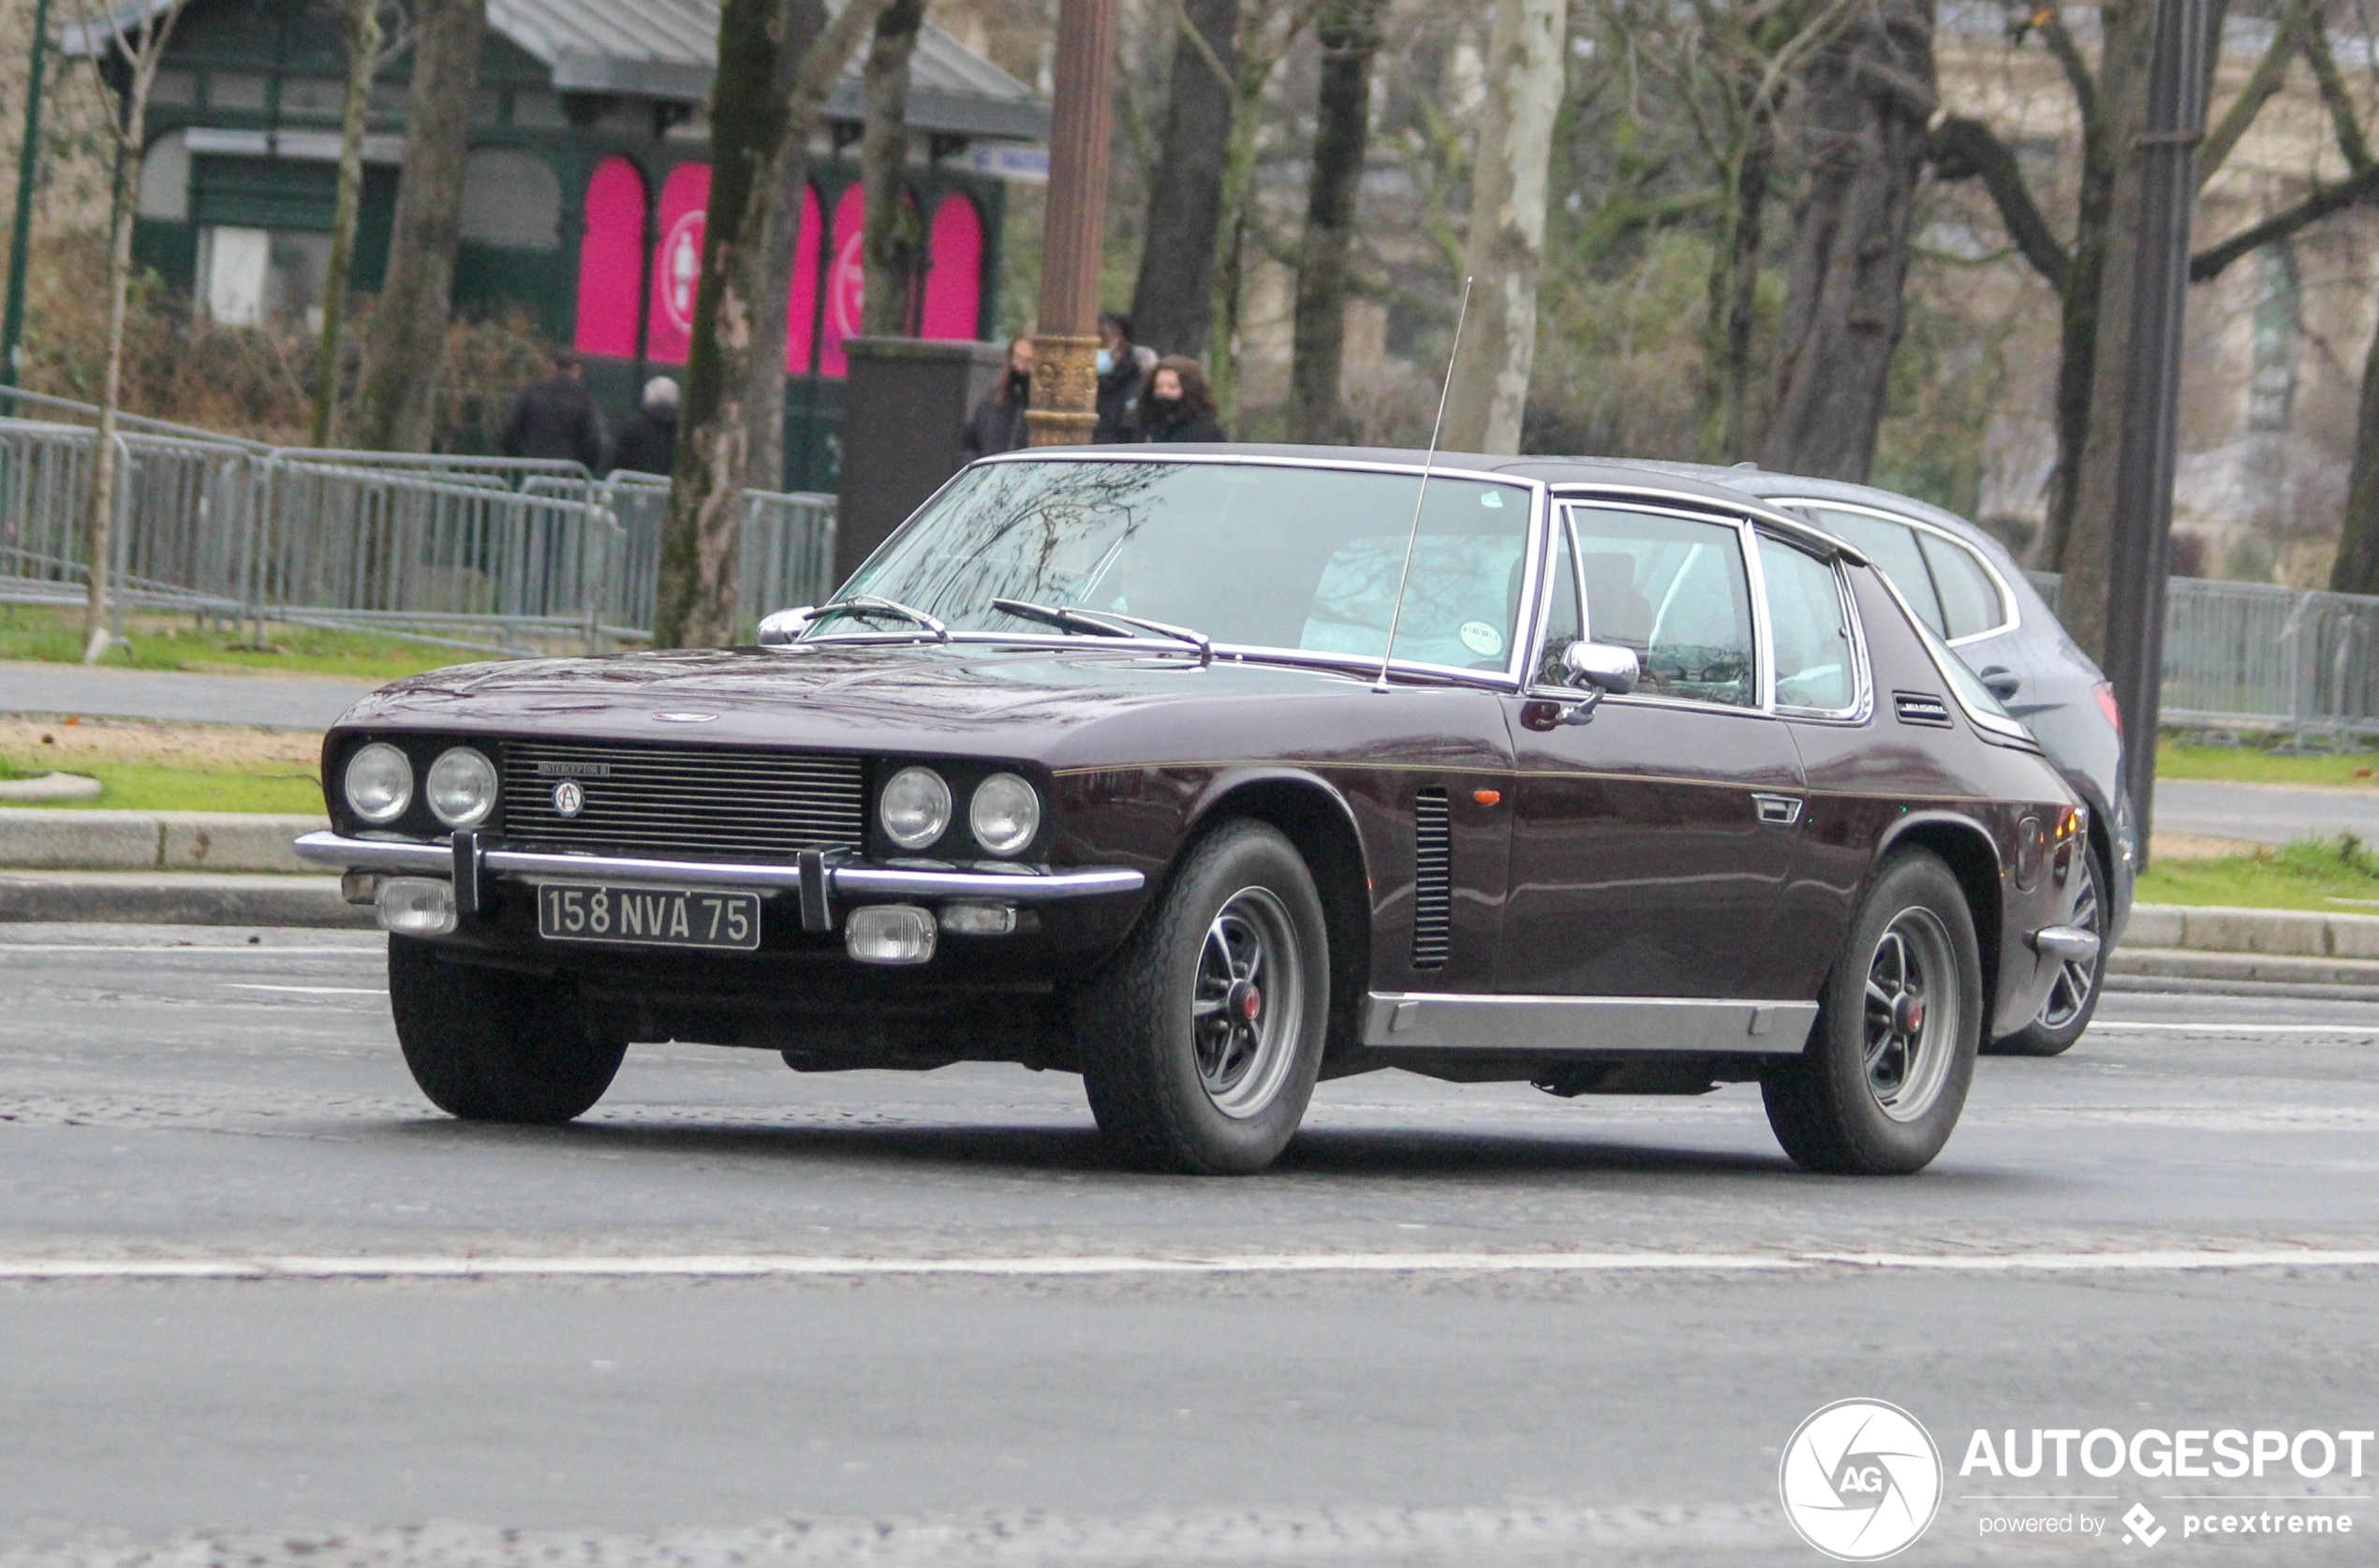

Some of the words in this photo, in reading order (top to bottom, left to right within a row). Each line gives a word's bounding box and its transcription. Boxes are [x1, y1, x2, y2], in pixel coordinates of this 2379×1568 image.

[540, 763, 598, 775] INTERCEPTOR
[549, 891, 610, 933] 158
[620, 894, 689, 937] NVA
[702, 899, 748, 940] 75
